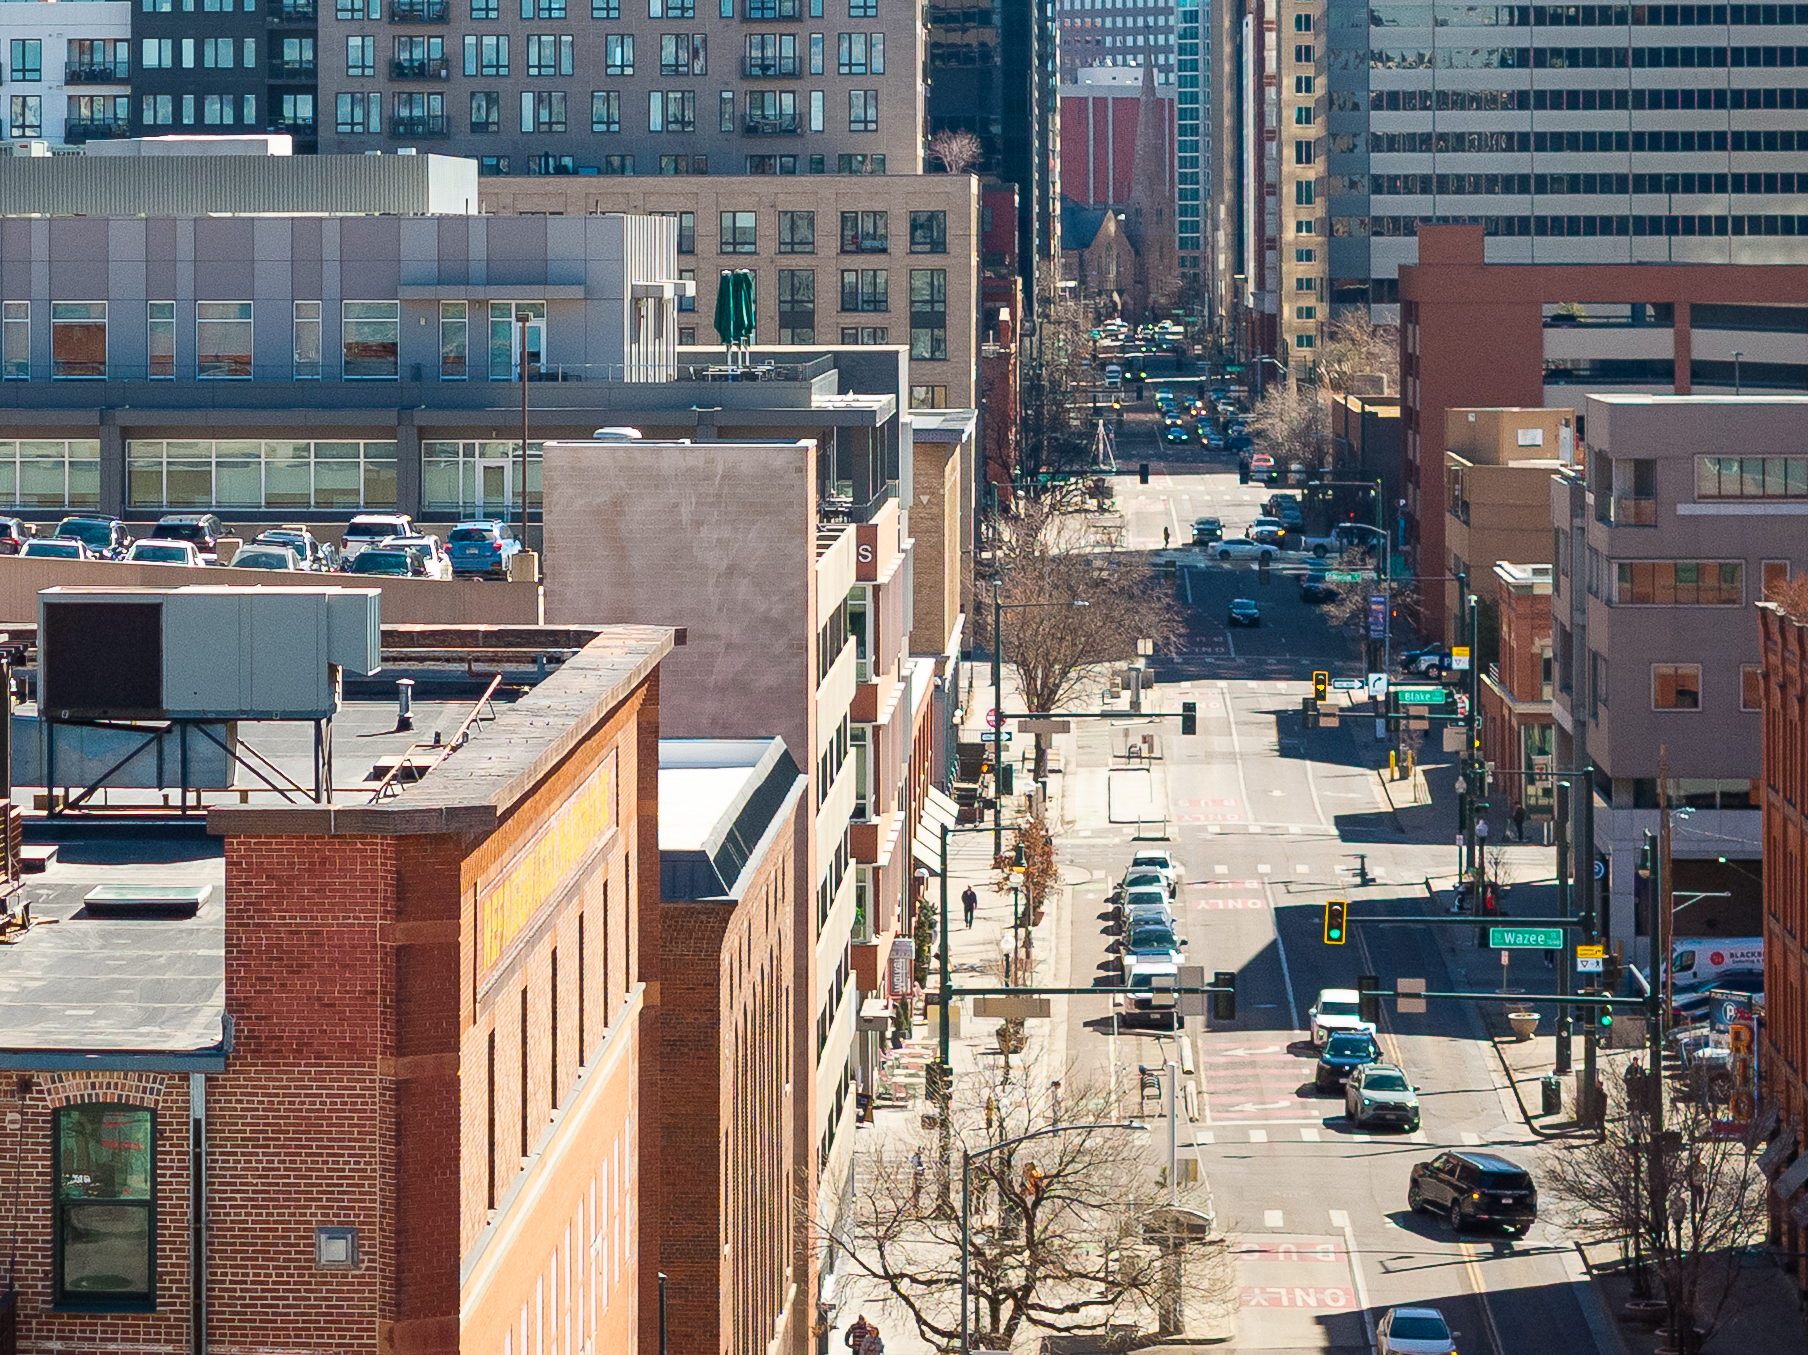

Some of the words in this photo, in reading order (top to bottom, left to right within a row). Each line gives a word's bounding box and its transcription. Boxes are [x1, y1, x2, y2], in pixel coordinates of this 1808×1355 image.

[1404, 692, 1431, 701] Blake
[1178, 799, 1236, 807] BUS
[1197, 899, 1262, 909] ONLY
[1503, 931, 1545, 945] Wazee
[1240, 1243, 1336, 1261] BUS
[1249, 1287, 1346, 1307] ONLY
